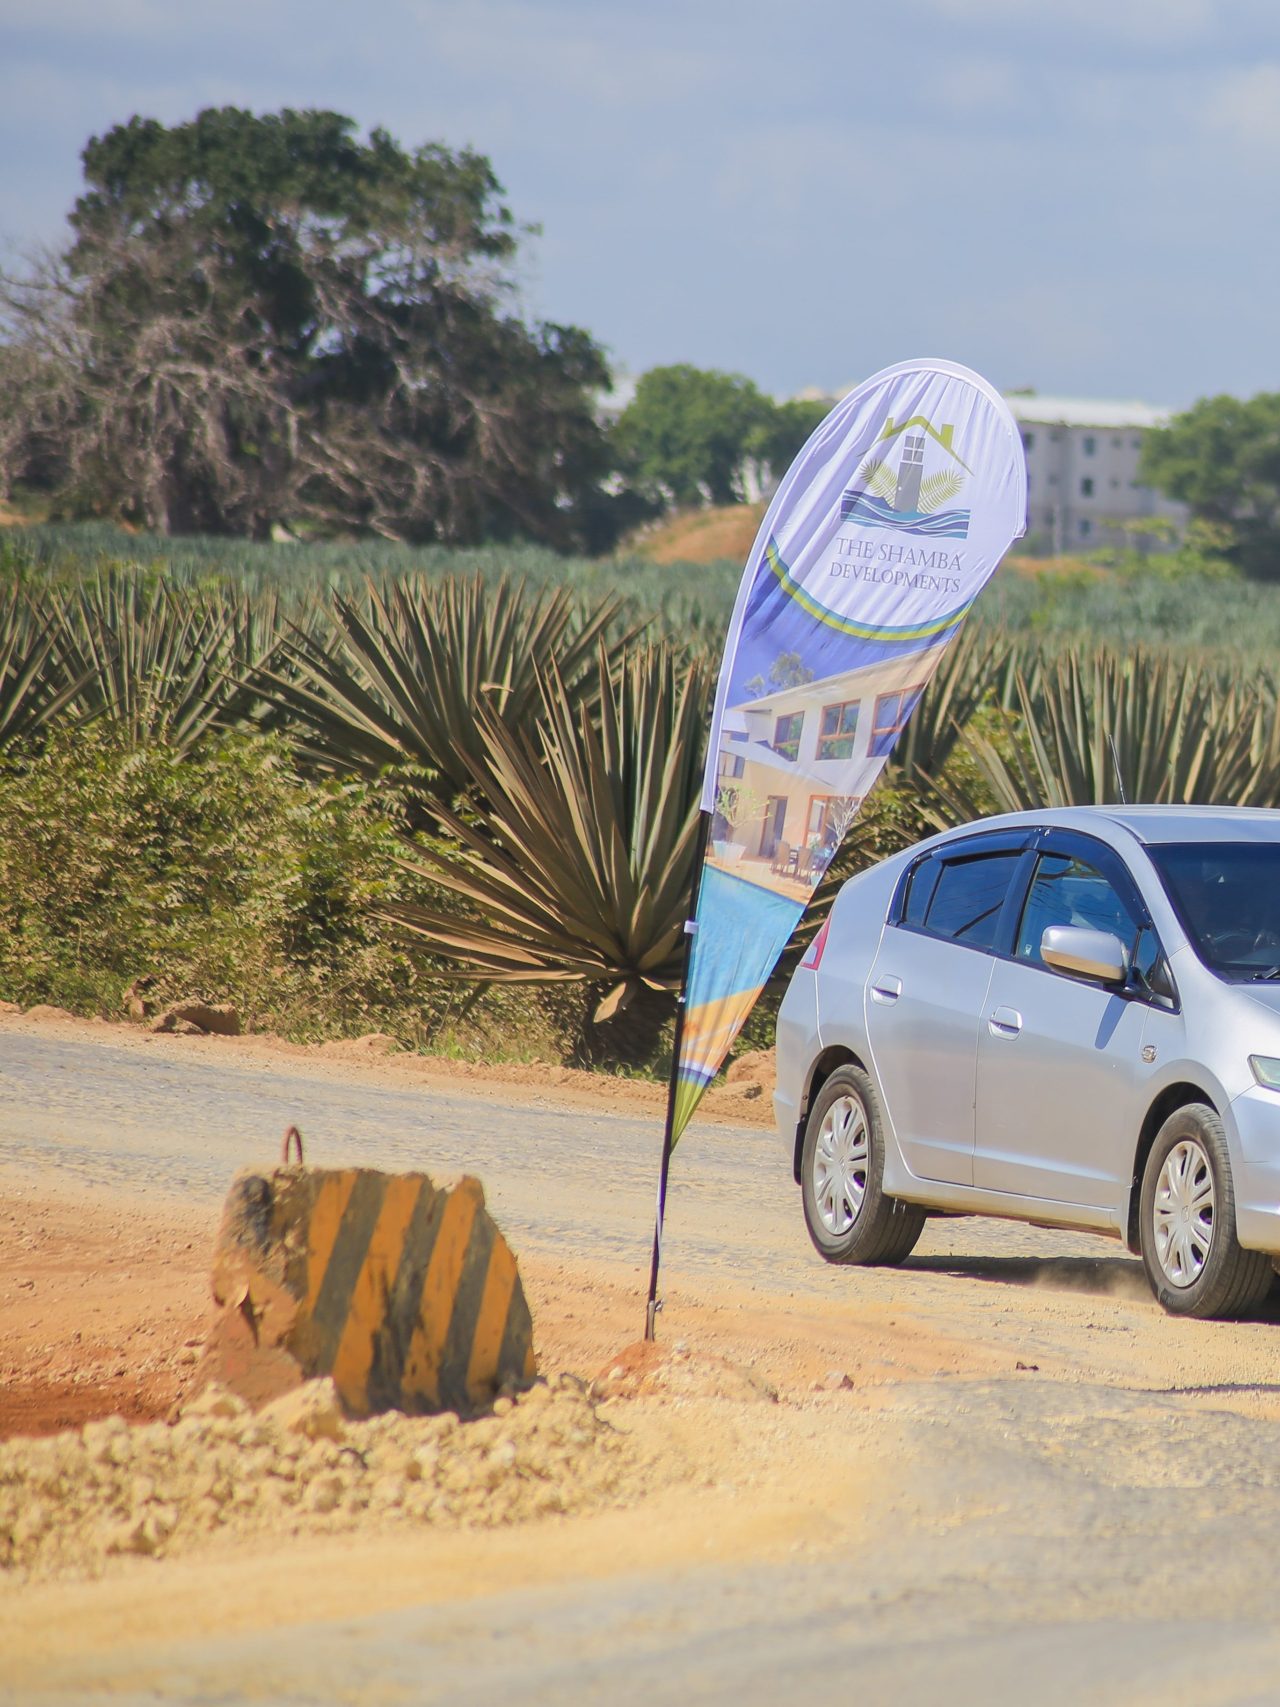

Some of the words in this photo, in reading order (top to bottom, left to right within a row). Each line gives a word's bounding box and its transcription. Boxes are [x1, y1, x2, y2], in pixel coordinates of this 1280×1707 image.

[836, 537, 874, 559] THE
[878, 543, 962, 571] SHAMBA
[829, 562, 961, 593] DEVELOPMENTS
